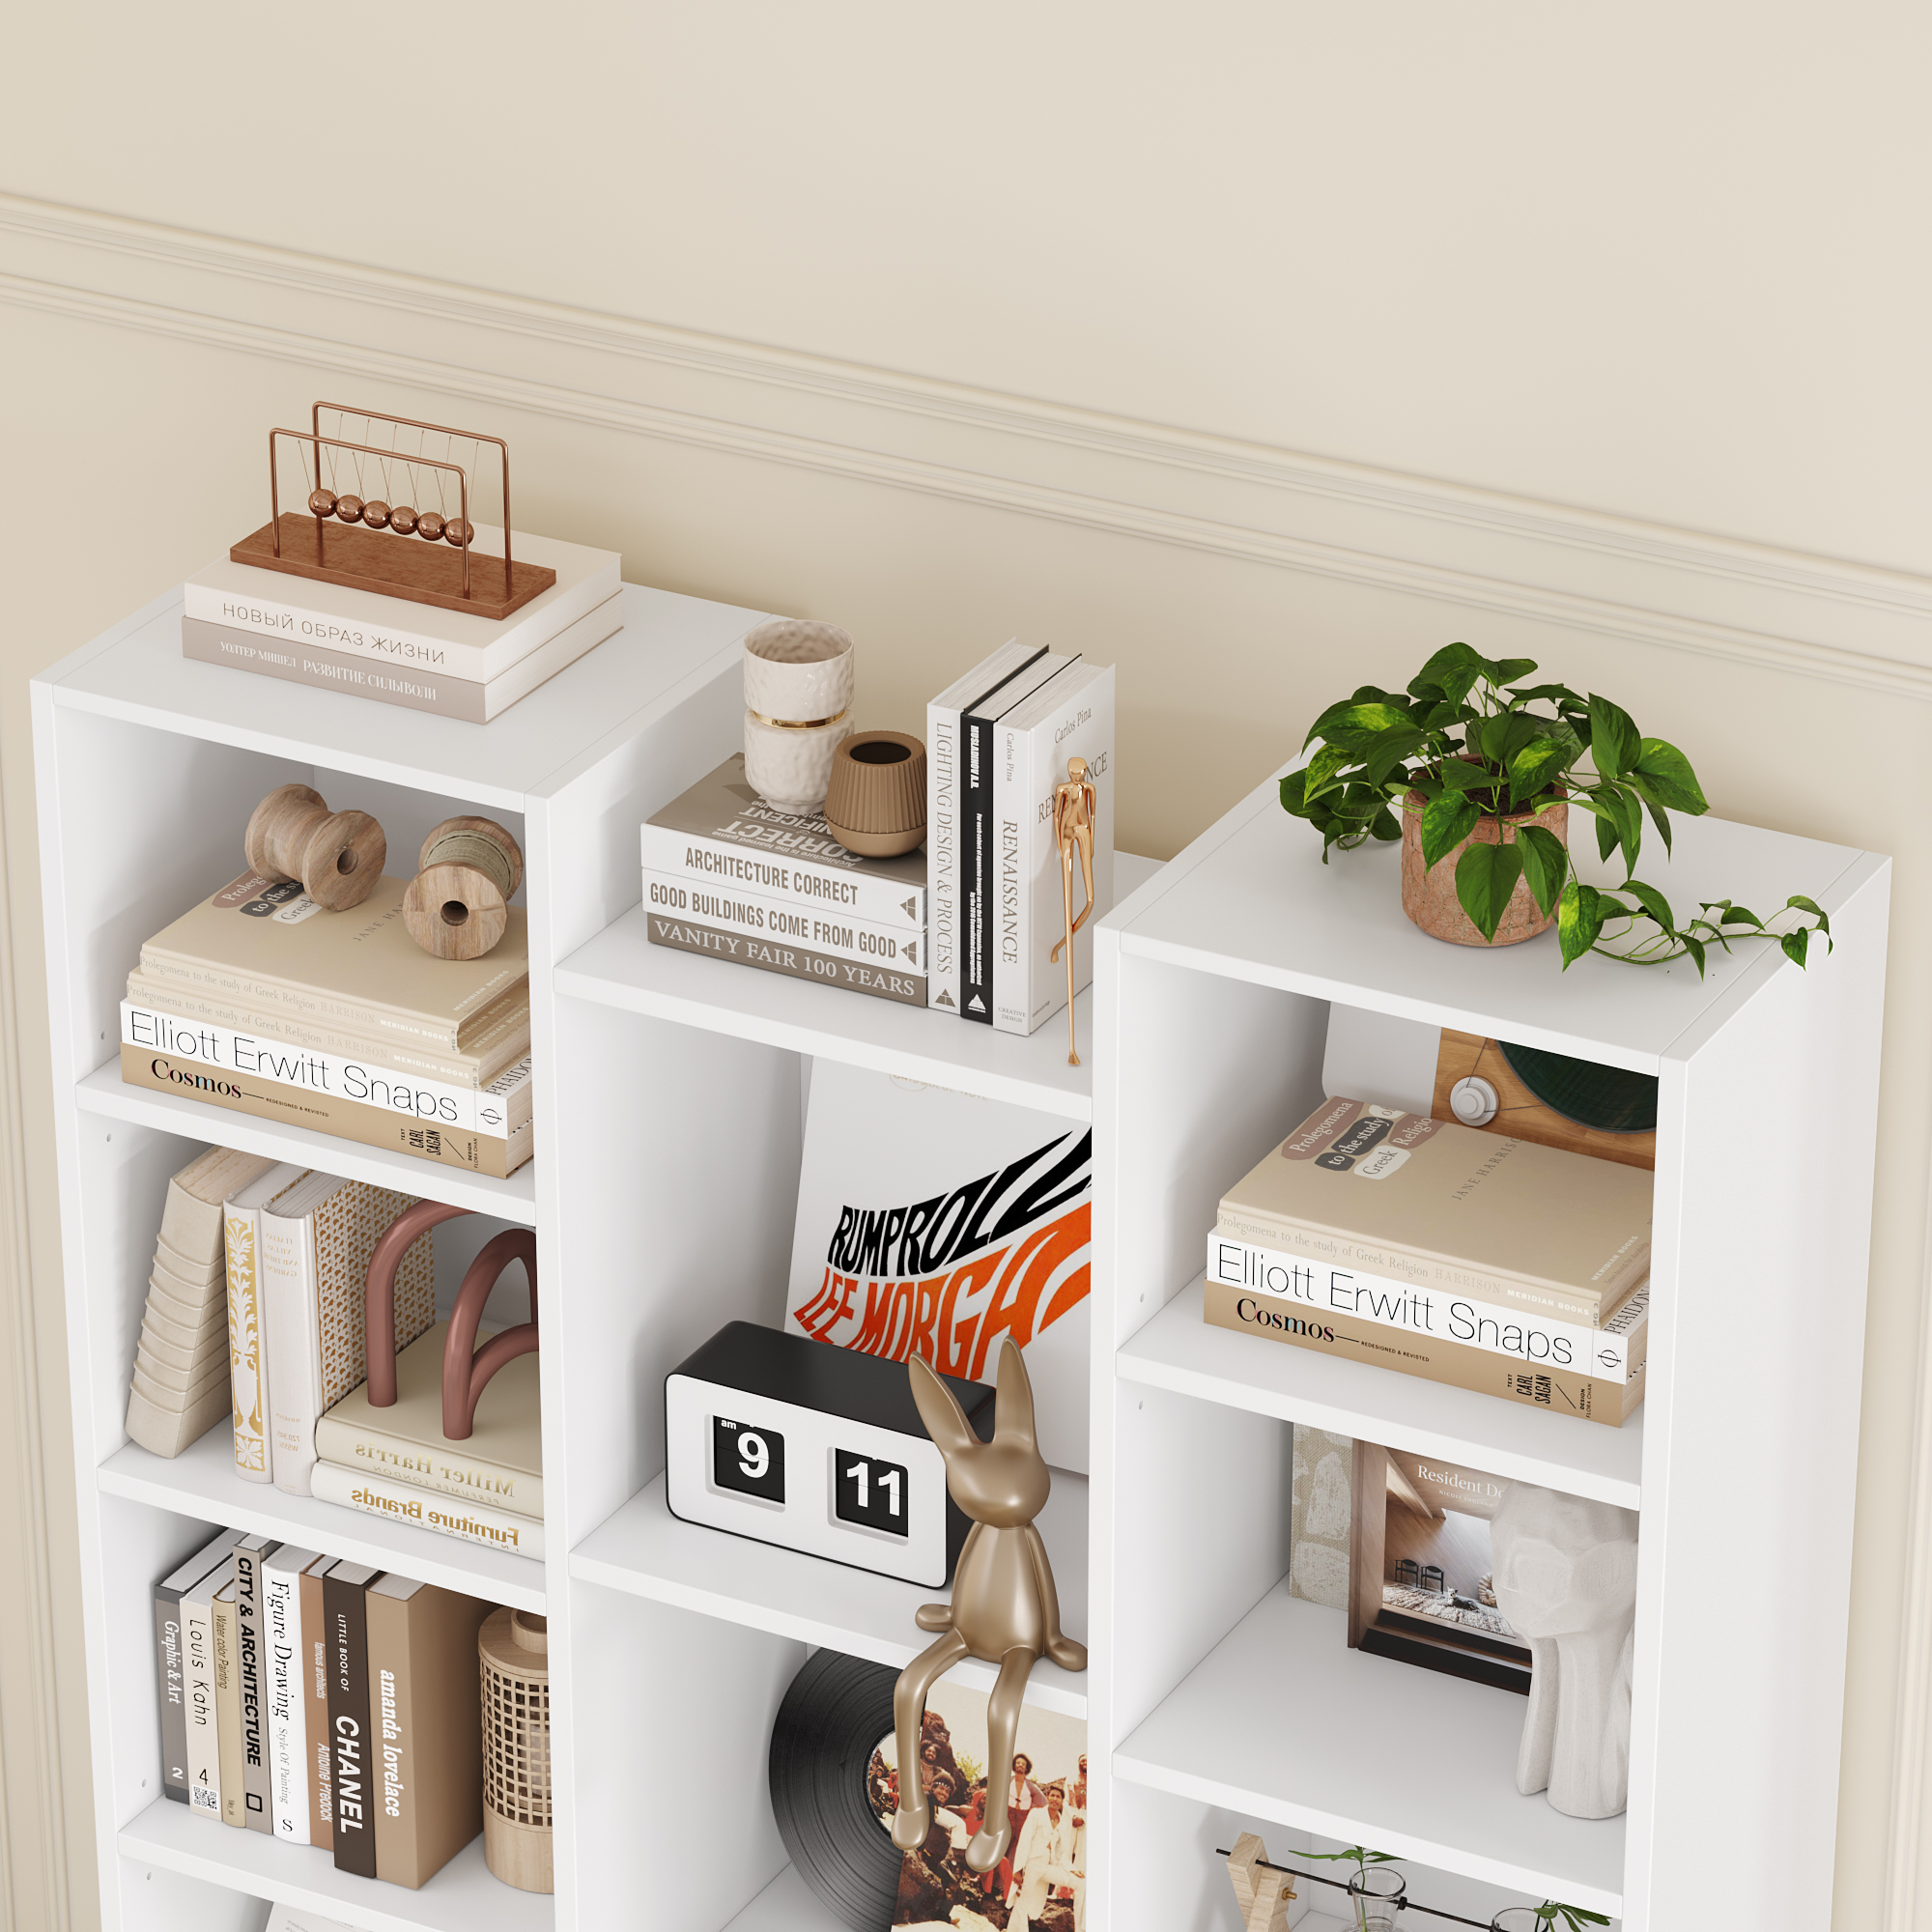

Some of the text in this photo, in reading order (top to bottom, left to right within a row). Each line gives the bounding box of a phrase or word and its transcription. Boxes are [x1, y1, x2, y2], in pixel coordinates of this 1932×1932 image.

[223, 602, 444, 665] НОВЫЙ ОБРАЗ ЖИЗНИ
[219, 640, 257, 658] УОЛТЕР
[257, 649, 297, 668] МИШЕЛ
[303, 659, 366, 685] РАЗВИТИЕ
[1054, 707, 1092, 744] Carlos Pina
[738, 806, 833, 836] NIFICENT
[936, 722, 952, 975] LIGHTING DESIGN & PROCESS
[220, 875, 268, 901] Proleg
[685, 846, 859, 906] ARCHITECTURE CORRECT
[1003, 819, 1018, 964] RENAISSANCE
[251, 888, 290, 913] to the
[650, 882, 896, 959] GOOD BUILDINGS COME FROM GOOD
[353, 920, 384, 943] JANE
[654, 920, 916, 997] VANITY FAIR 100 YEARS
[139, 955, 190, 979] Prolegomena
[192, 970, 202, 980] to
[204, 972, 217, 985] the
[219, 977, 241, 994] study
[243, 982, 254, 993] of
[255, 985, 279, 1001] Greek
[282, 992, 316, 1011] Religion
[320, 1001, 376, 1024] HARRISON
[380, 1018, 419, 1035] MERIDIAN
[421, 1029, 449, 1042] BOOKS
[453, 986, 486, 1012] MERIDIAN
[485, 969, 510, 987] BOOKS
[997, 1007, 1027, 1018] CREATIVE
[126, 983, 182, 1008] Prolegomena
[185, 1000, 195, 1010] to
[198, 1002, 213, 1015] the
[214, 1007, 239, 1025] study
[242, 1012, 252, 1024] of
[254, 1016, 281, 1033] Greek
[285, 1024, 322, 1044] Religion
[327, 1035, 387, 1059] HARRISON
[393, 1054, 438, 1071] MERIDIAN
[440, 1065, 470, 1080] BOOKS
[472, 1023, 507, 1049] MERIDIAN
[505, 1007, 529, 1024] BOOKS
[1001, 1013, 1023, 1024] DESIGN
[131, 1010, 221, 1063] Elliott
[234, 1036, 330, 1091] Erwitt
[344, 1065, 458, 1122] Snaps
[151, 1058, 242, 1099] Cosmos
[485, 1056, 531, 1096] PHAIDO
[266, 1096, 298, 1110] REDESIGNED
[304, 1107, 329, 1118] REVISTED
[1289, 1101, 1353, 1153] Prolegomena
[410, 1128, 424, 1149] CARL
[426, 1128, 440, 1156] SAGAN
[1328, 1117, 1390, 1166] to the study
[1392, 1117, 1434, 1147] Religio
[1362, 1150, 1399, 1176] Greek
[1451, 1136, 1523, 1201] JANE HARRISO
[827, 1125, 1092, 1277] RUMPROLL
[1217, 1212, 1277, 1238] Prolegomena
[1281, 1231, 1292, 1242] to
[1294, 1233, 1310, 1247] the
[1313, 1238, 1339, 1258] study
[1342, 1245, 1354, 1257] of
[1356, 1248, 1385, 1265] Greek
[1388, 1256, 1429, 1278] Religion
[1435, 1267, 1501, 1294] HARRISON
[1506, 1289, 1554, 1307] MERIDIAN
[1557, 1300, 1590, 1317] BOOKS
[1590, 1254, 1621, 1282] MERIDIAN
[1617, 1236, 1638, 1254] BOOKS
[1218, 1243, 1315, 1301] Elliott
[1330, 1271, 1435, 1331] Erwitt
[1448, 1301, 1573, 1365] Snaps
[1236, 1297, 1335, 1344] Cosmos
[1360, 1340, 1397, 1355] REDESIGNED
[1403, 1350, 1431, 1363] REVISTED
[1516, 1374, 1533, 1397] CARL
[1534, 1374, 1552, 1405] SAGAN
[721, 1419, 737, 1431] am
[737, 1432, 770, 1479] 9
[1417, 1464, 1483, 1494] Resident
[846, 1461, 901, 1517] 11
[1438, 1490, 1494, 1508] NICOLE ENGLAND
[215, 1614, 230, 1690] Water color Painting
[238, 1556, 262, 1768] CITY & ARCHITECTURE
[314, 1641, 327, 1700] famous architects
[337, 1613, 350, 1692] LITTLE BOOK OF
[160, 1620, 184, 1780] Graphic & Art 2
[189, 1619, 211, 1786] Louis Kahn 4
[267, 1578, 295, 1833] Figure Drawing Style Of Painting S
[380, 1669, 405, 1818] amanda lovelace
[317, 1742, 333, 1823] Antoine Predock
[335, 1715, 363, 1833] CHANEL
